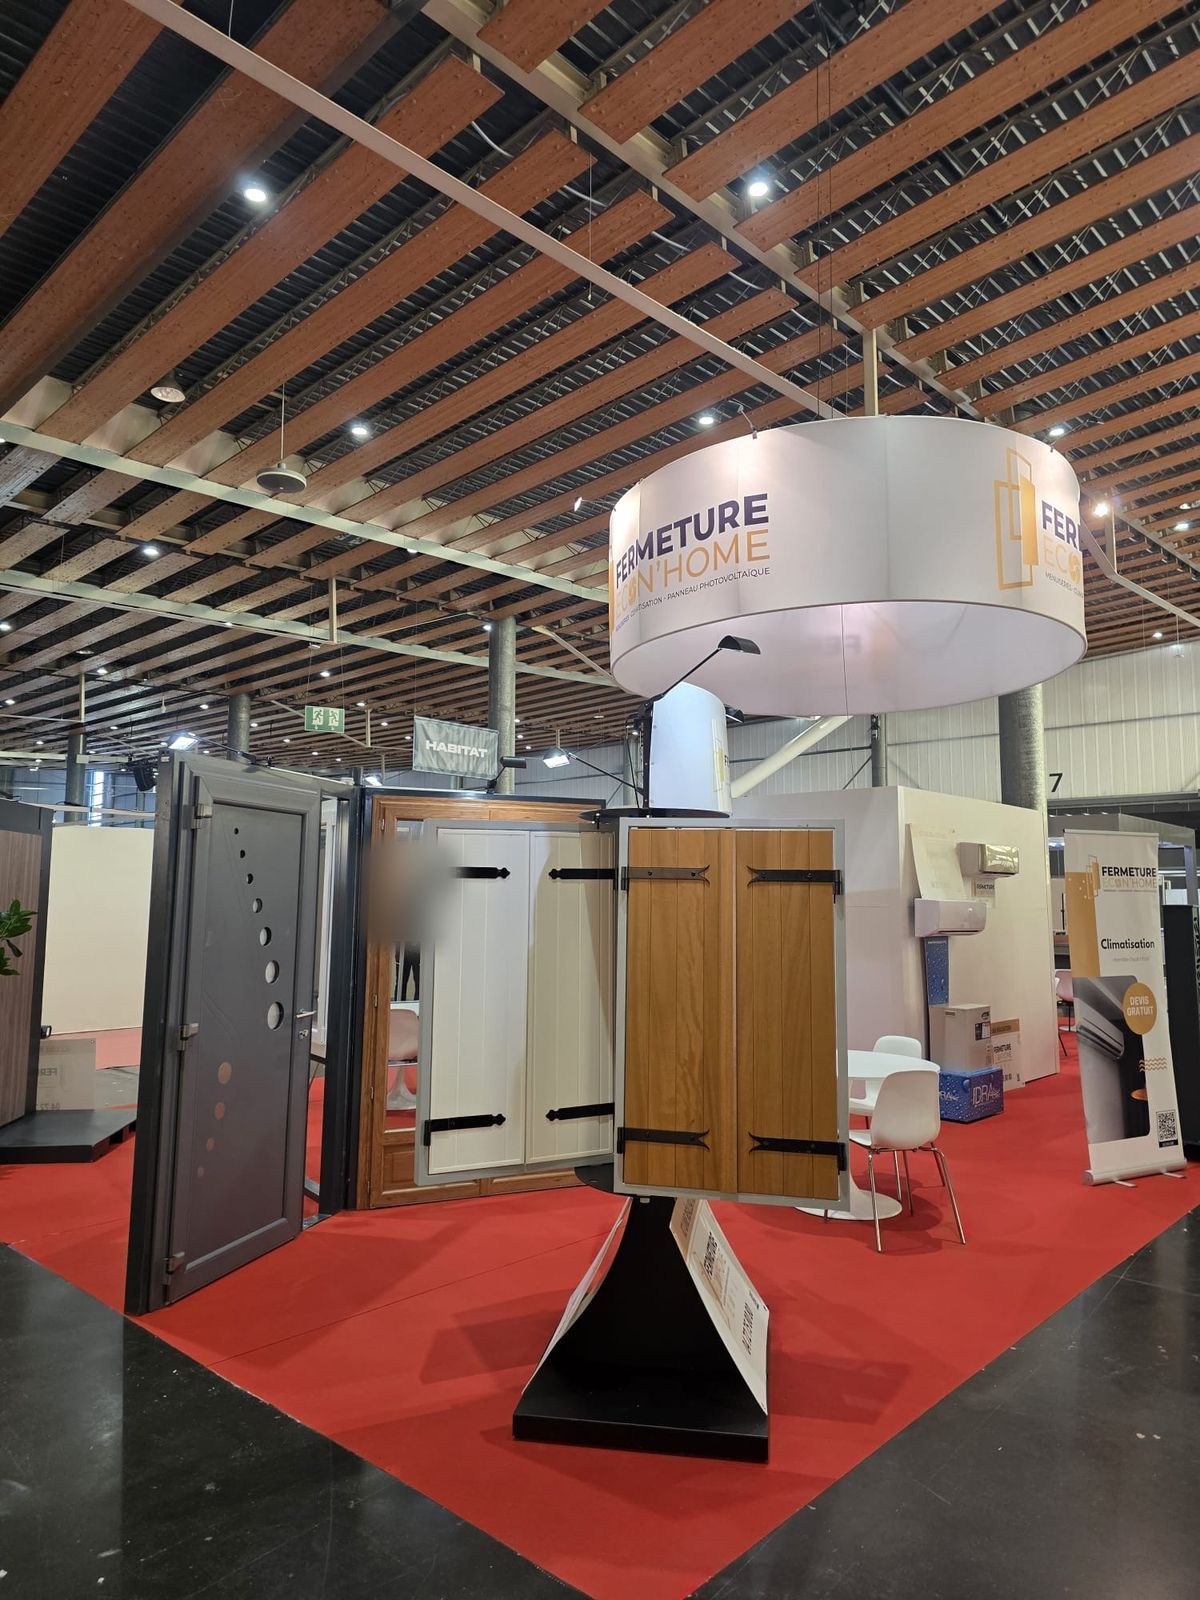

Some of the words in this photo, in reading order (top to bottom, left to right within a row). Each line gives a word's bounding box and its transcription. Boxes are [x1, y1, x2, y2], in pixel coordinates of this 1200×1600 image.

[1041, 500, 1081, 550] FER
[616, 493, 769, 589] FERMETURE
[667, 584, 698, 600] PANNEAU
[425, 740, 488, 758] HABITAT
[1049, 772, 1063, 793] 7
[1101, 866, 1157, 877] FERMETURE
[1100, 938, 1155, 950] Climatisation
[1129, 996, 1150, 1006] DEVIS
[1126, 1006, 1154, 1016] GRATUIT
